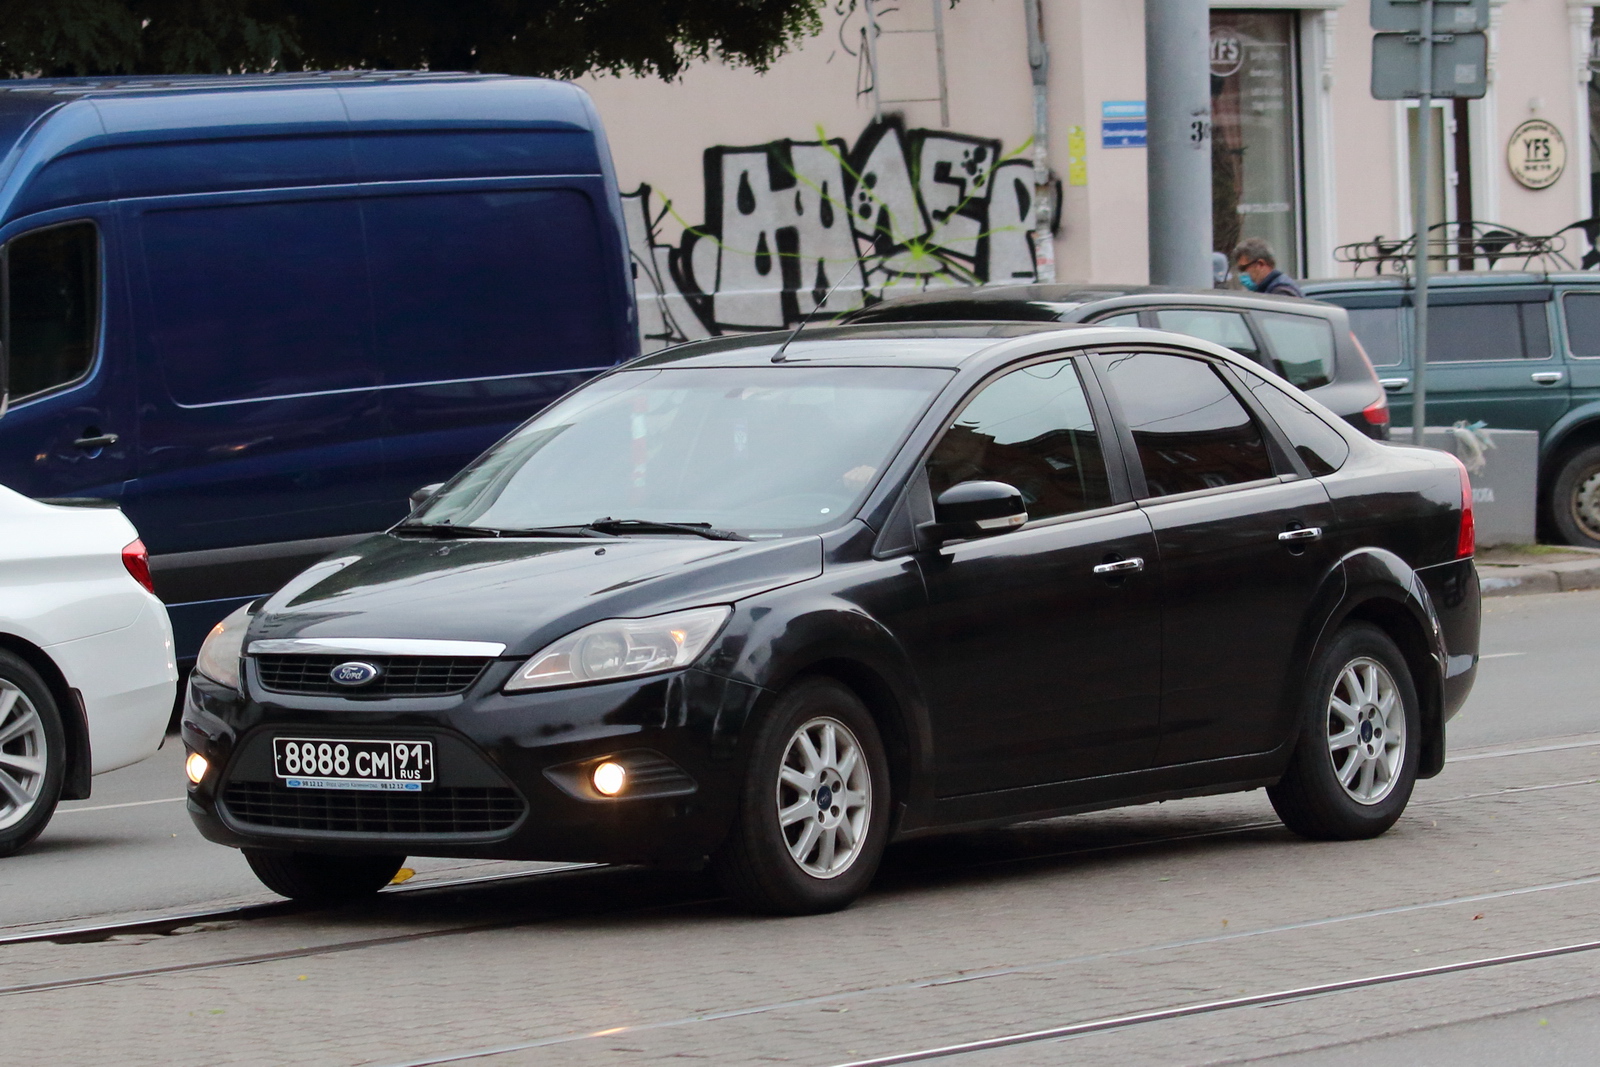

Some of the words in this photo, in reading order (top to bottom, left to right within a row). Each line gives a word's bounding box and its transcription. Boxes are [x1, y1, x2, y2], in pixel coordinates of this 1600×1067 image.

[1523, 138, 1551, 159] YFS
[339, 666, 364, 680] Ford
[285, 742, 350, 776] 8888
[395, 744, 423, 769] 91
[400, 769, 421, 779] RUS
